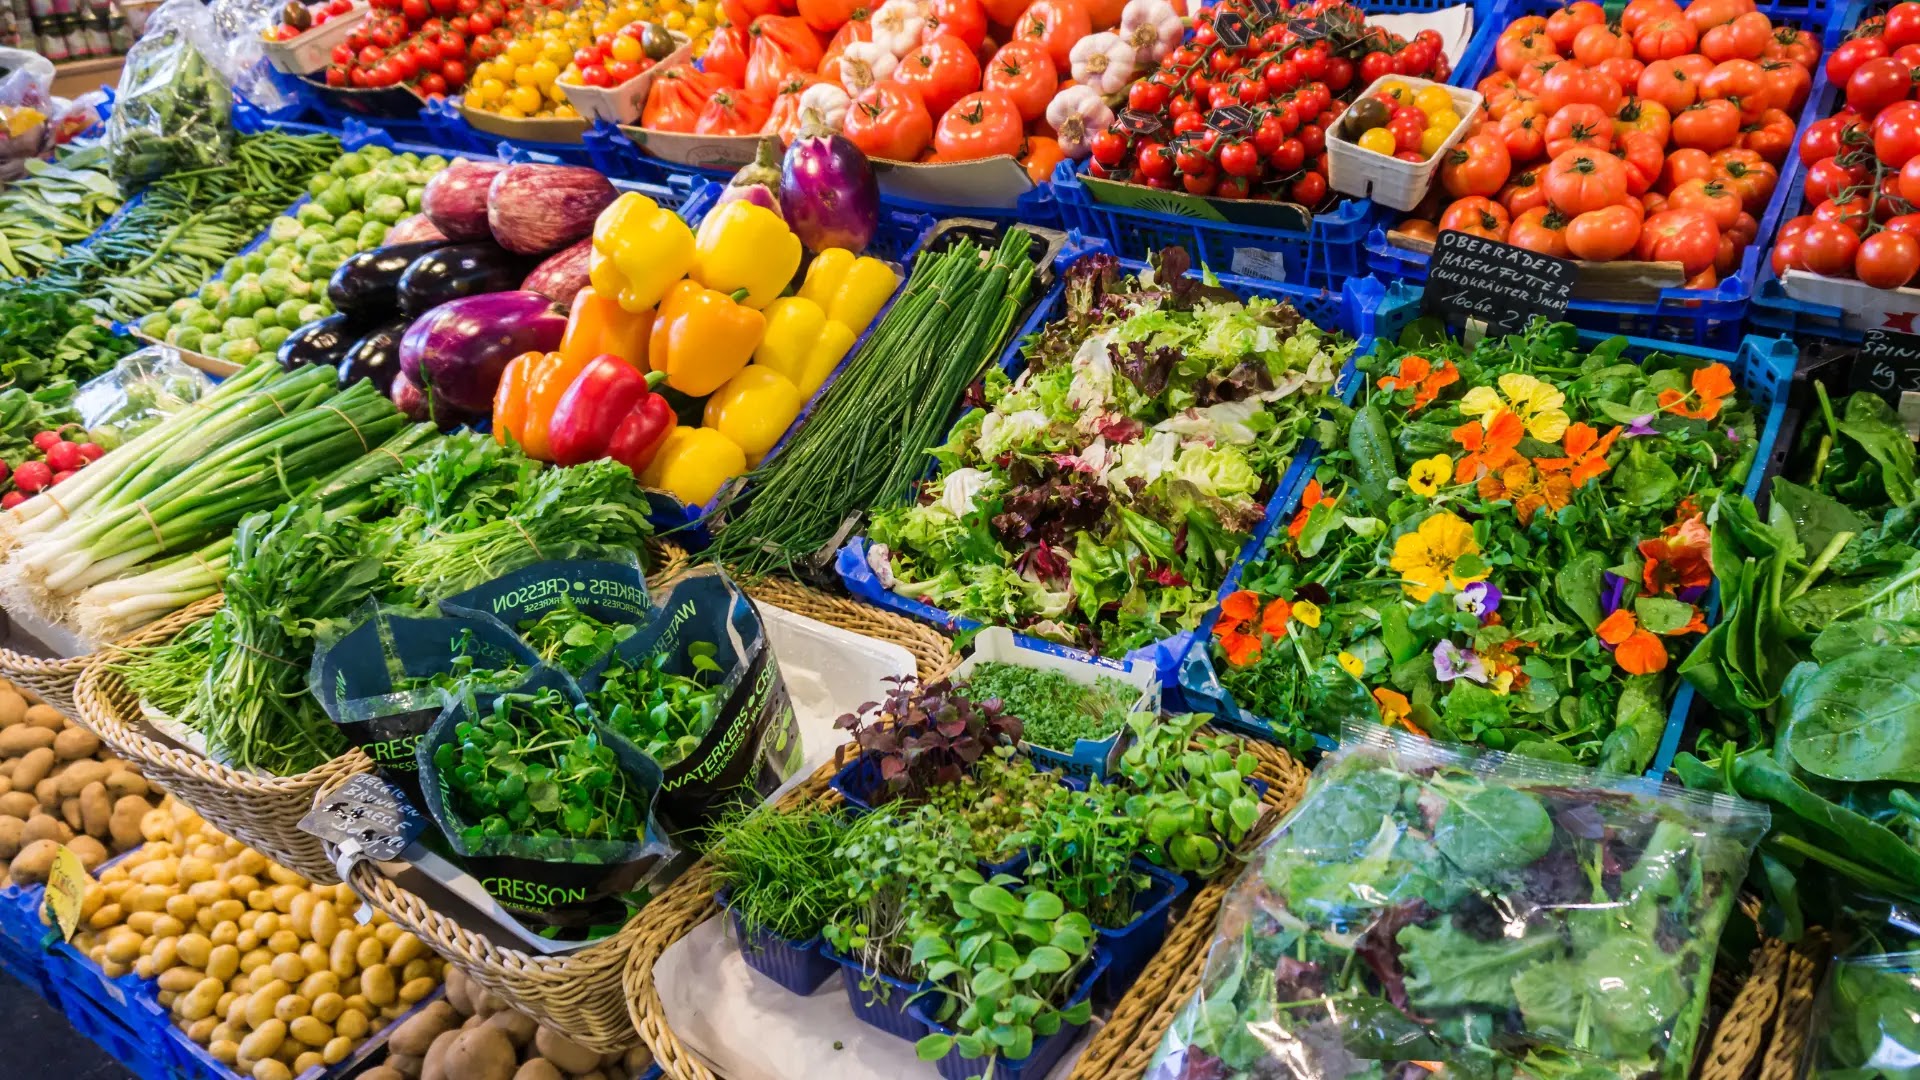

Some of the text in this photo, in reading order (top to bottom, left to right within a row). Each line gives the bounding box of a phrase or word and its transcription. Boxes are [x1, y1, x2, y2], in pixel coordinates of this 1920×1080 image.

[1442, 233, 1563, 278] OBERRÄDER
[1861, 341, 1920, 361] SPIN
[661, 706, 748, 793] WATERKERS
[704, 732, 746, 784] WATERCRESS
[481, 877, 586, 906] CRESSON
